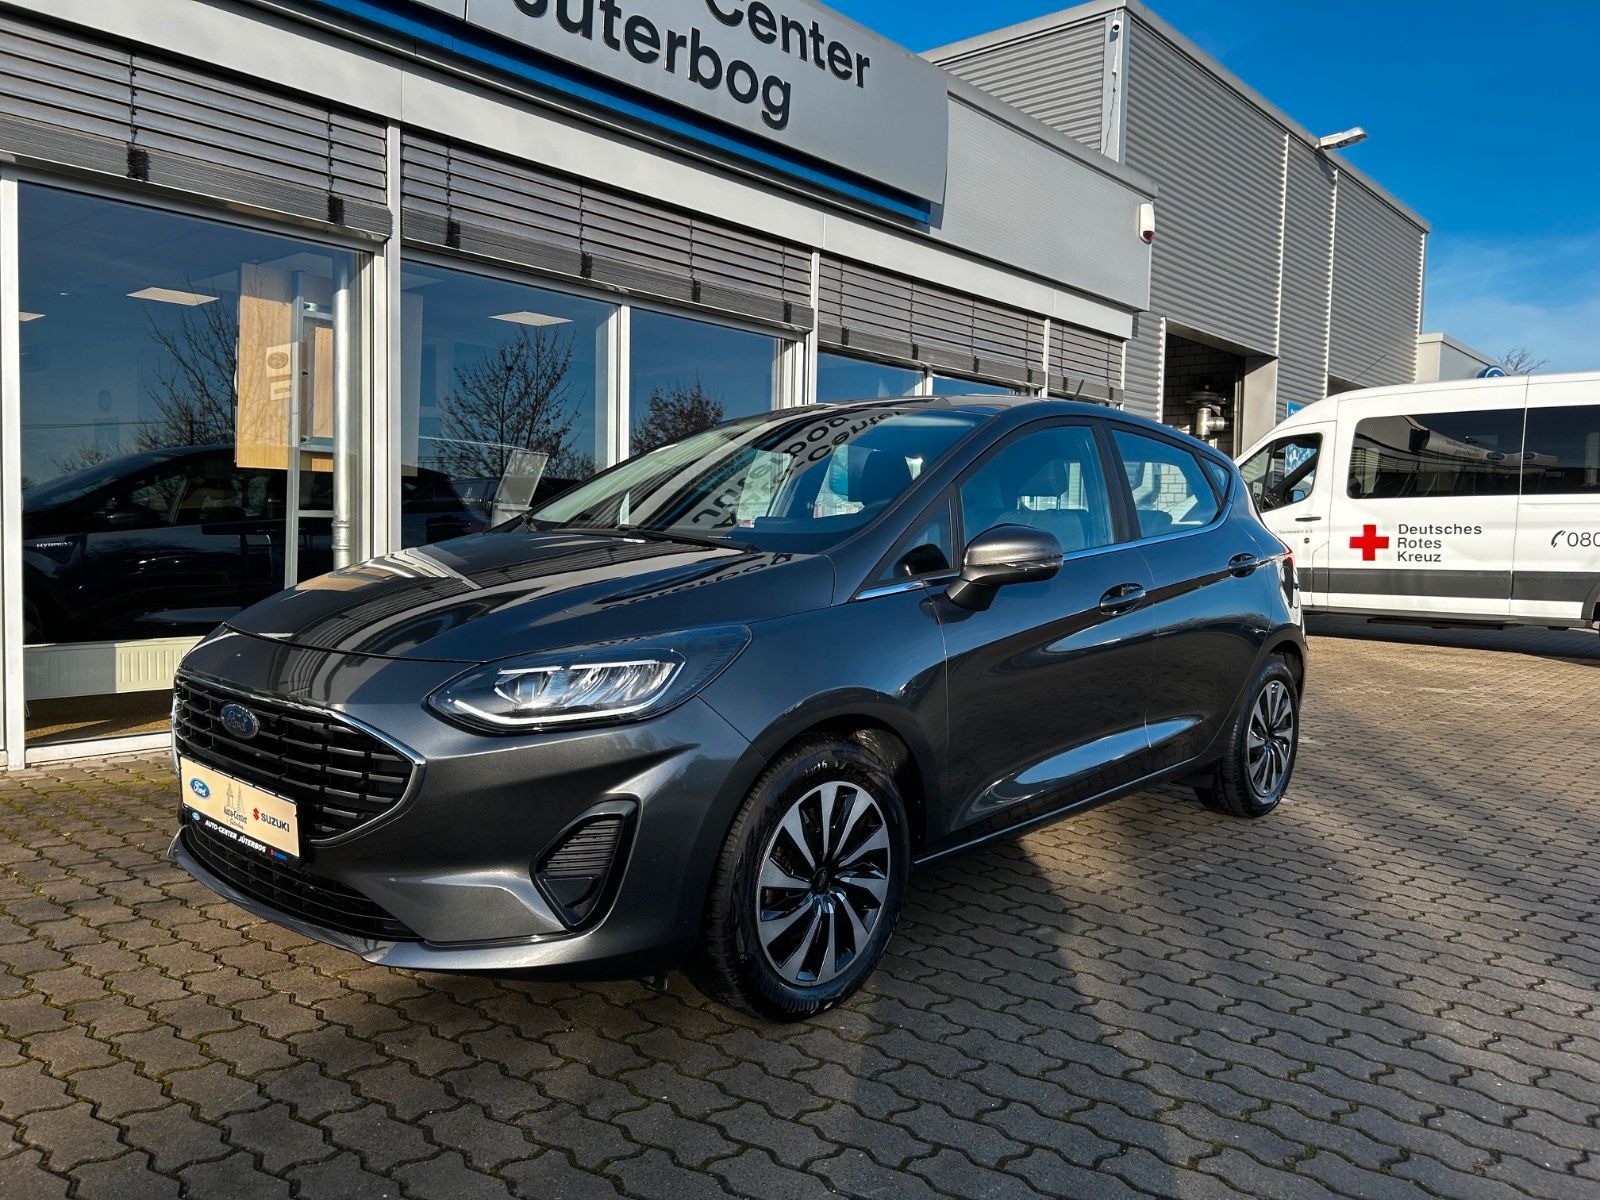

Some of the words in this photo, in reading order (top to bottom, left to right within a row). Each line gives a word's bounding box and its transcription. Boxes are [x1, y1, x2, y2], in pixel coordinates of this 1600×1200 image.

[1397, 523, 1482, 535] Deutsches
[1397, 537, 1442, 549] Rotes
[1397, 550, 1442, 562] Kreuz
[193, 780, 207, 797] Ford
[260, 812, 290, 832] SUZUKI
[204, 820, 238, 840] AUTO-CENTER
